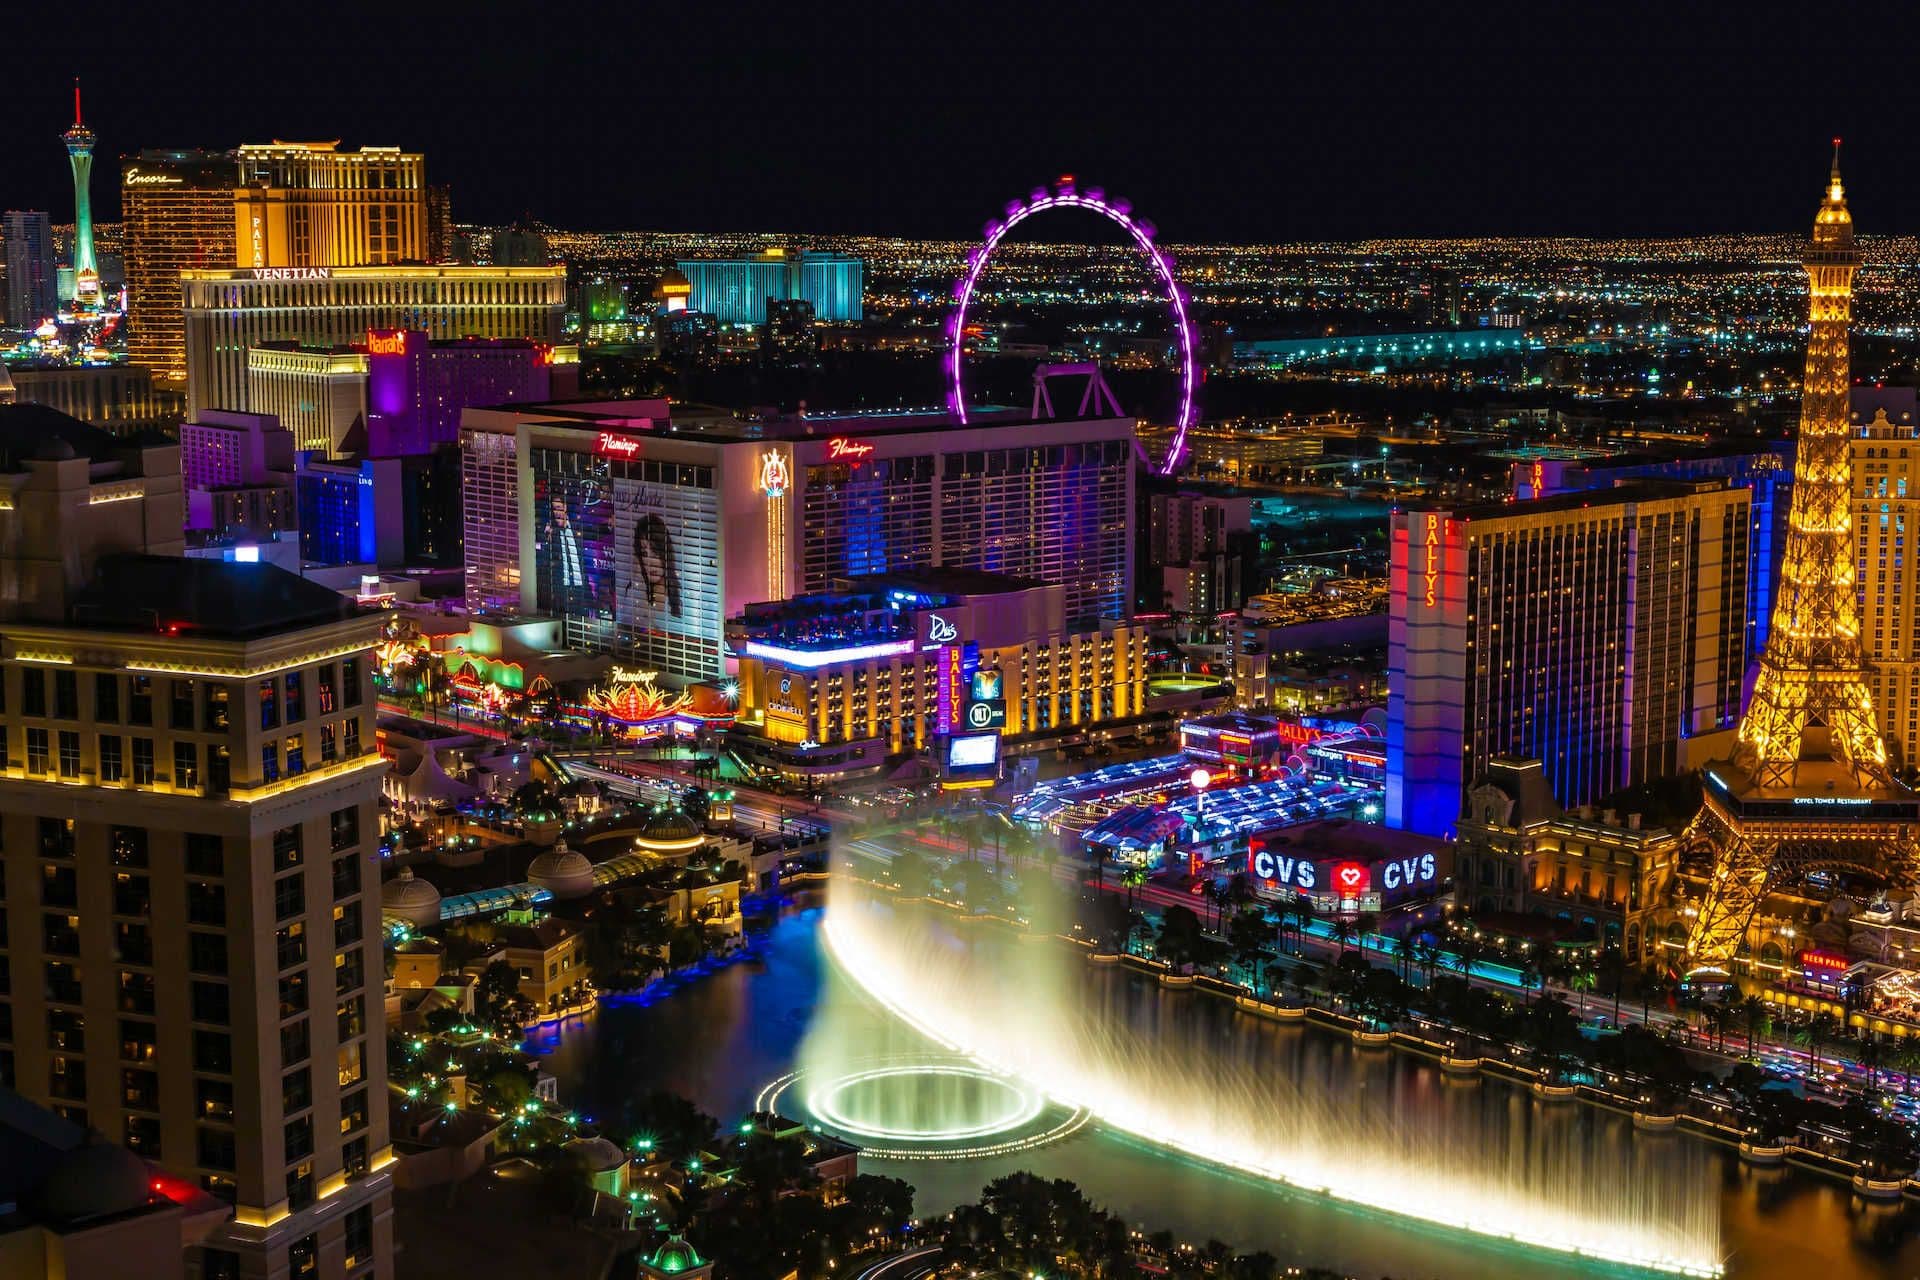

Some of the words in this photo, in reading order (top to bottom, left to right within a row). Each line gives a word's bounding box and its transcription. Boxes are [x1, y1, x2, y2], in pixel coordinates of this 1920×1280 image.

[126, 167, 183, 185] Encore
[253, 267, 329, 280] VENETIAN
[600, 432, 640, 457] Flamingo
[612, 665, 659, 687] Flamingo
[1279, 723, 1321, 744] BALLY'S
[1254, 851, 1315, 888] CVS
[1383, 853, 1436, 889] CVS
[1825, 958, 1847, 970] PARK
